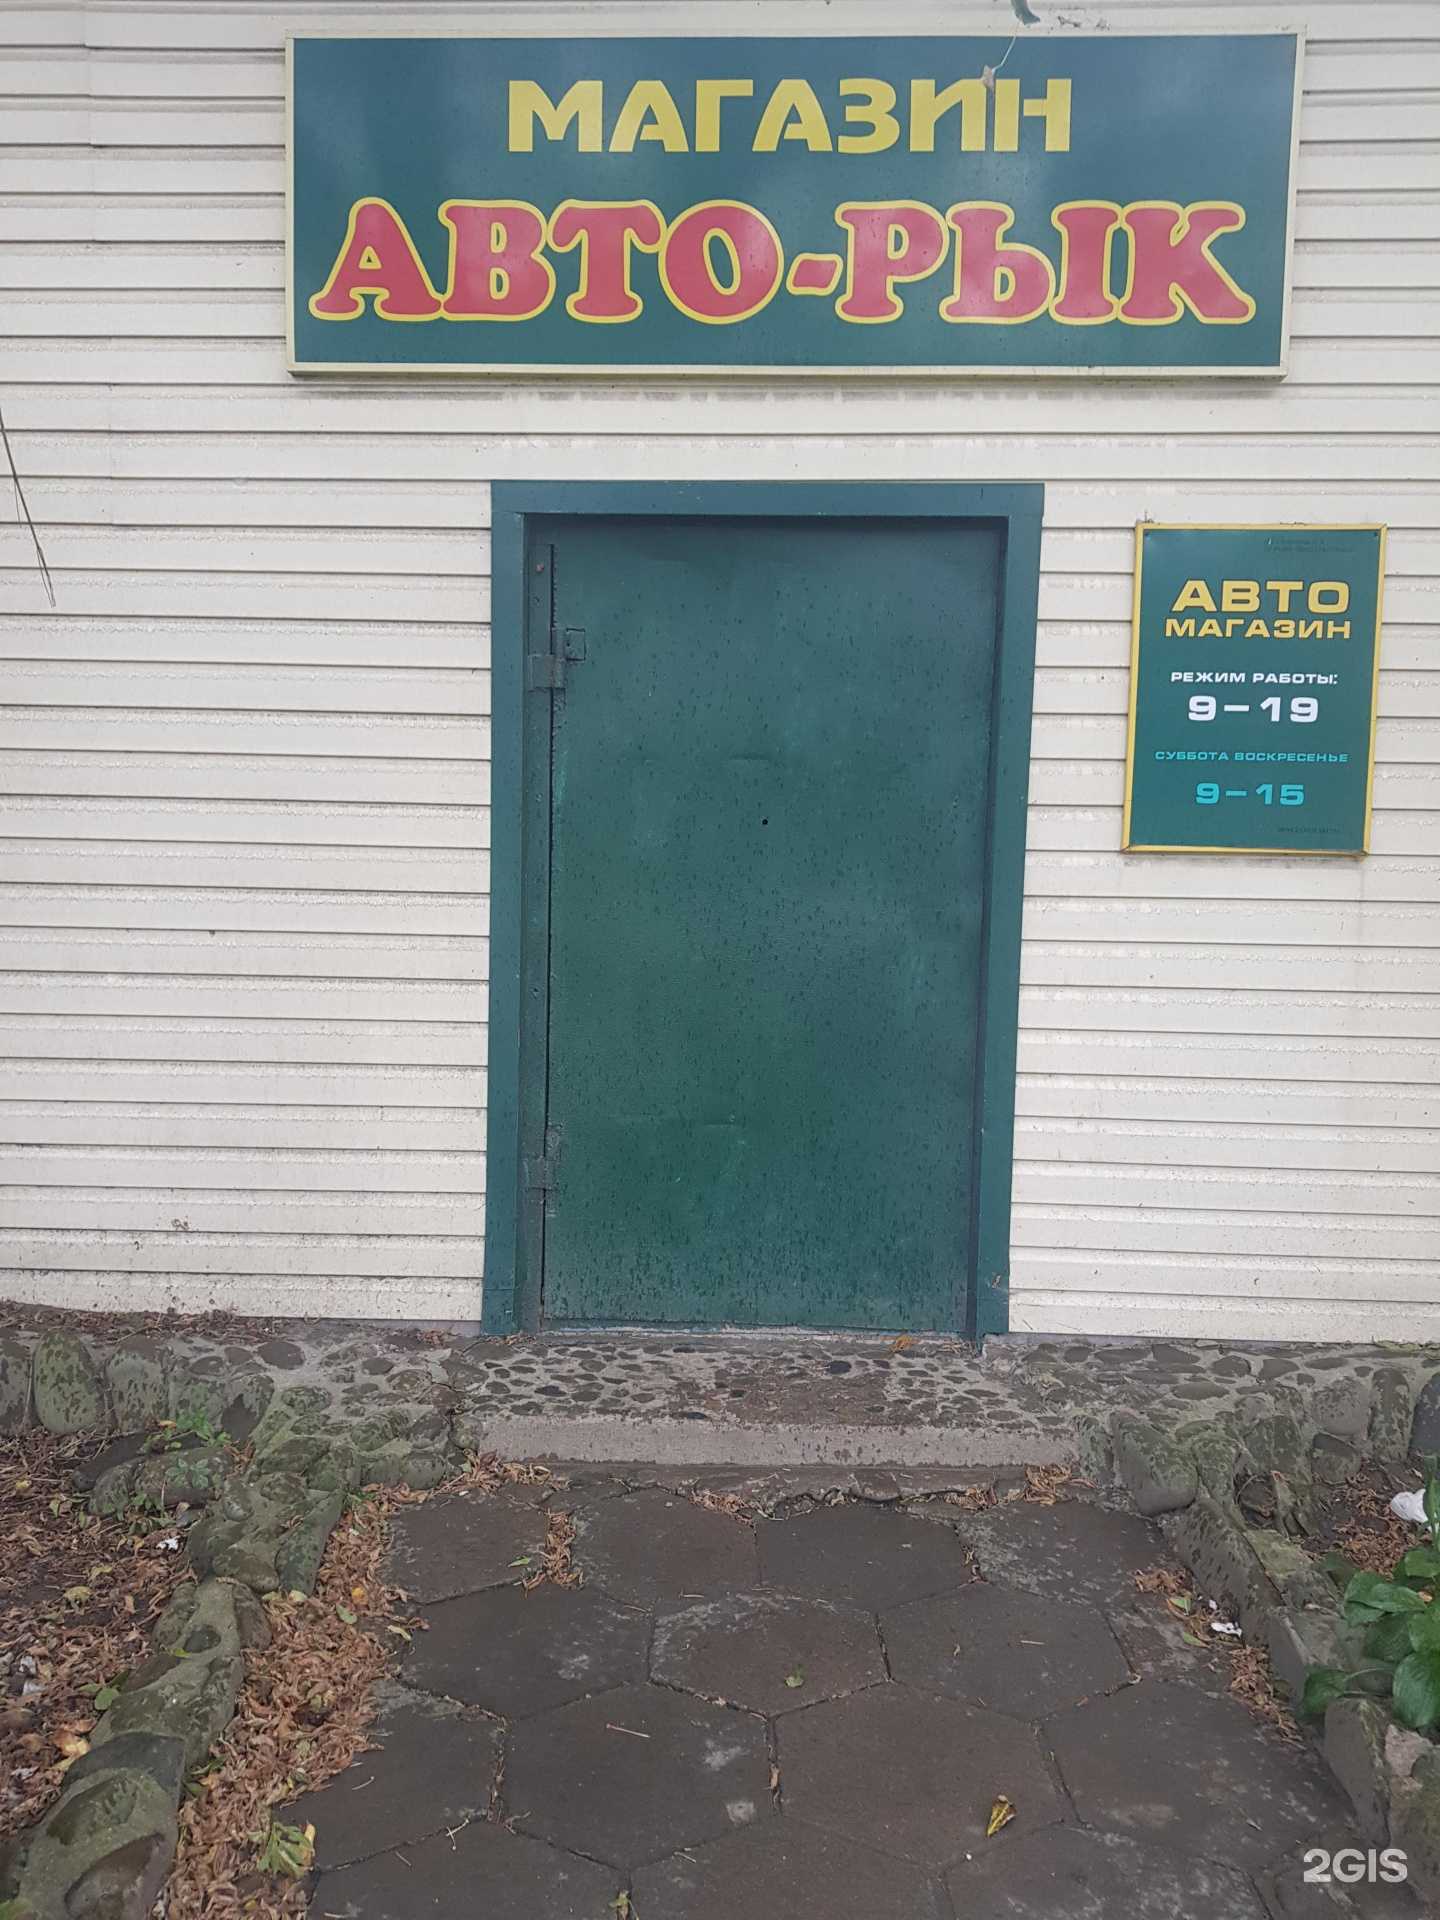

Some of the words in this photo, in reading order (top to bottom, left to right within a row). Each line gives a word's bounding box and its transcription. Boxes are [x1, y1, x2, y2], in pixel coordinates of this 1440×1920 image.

[507, 78, 1072, 154] МАГАЗИН
[309, 196, 1257, 326] АВТО-РЫК
[1171, 579, 1351, 614] АВТО
[1164, 618, 1352, 640] МАГАЗИН
[1170, 671, 1246, 684] РЕЖИМ
[1252, 672, 1339, 685] РАБОТЫ:
[1154, 751, 1230, 762] СУББОТА
[1234, 752, 1349, 763] ВОСКРЕСЕНЬЕ
